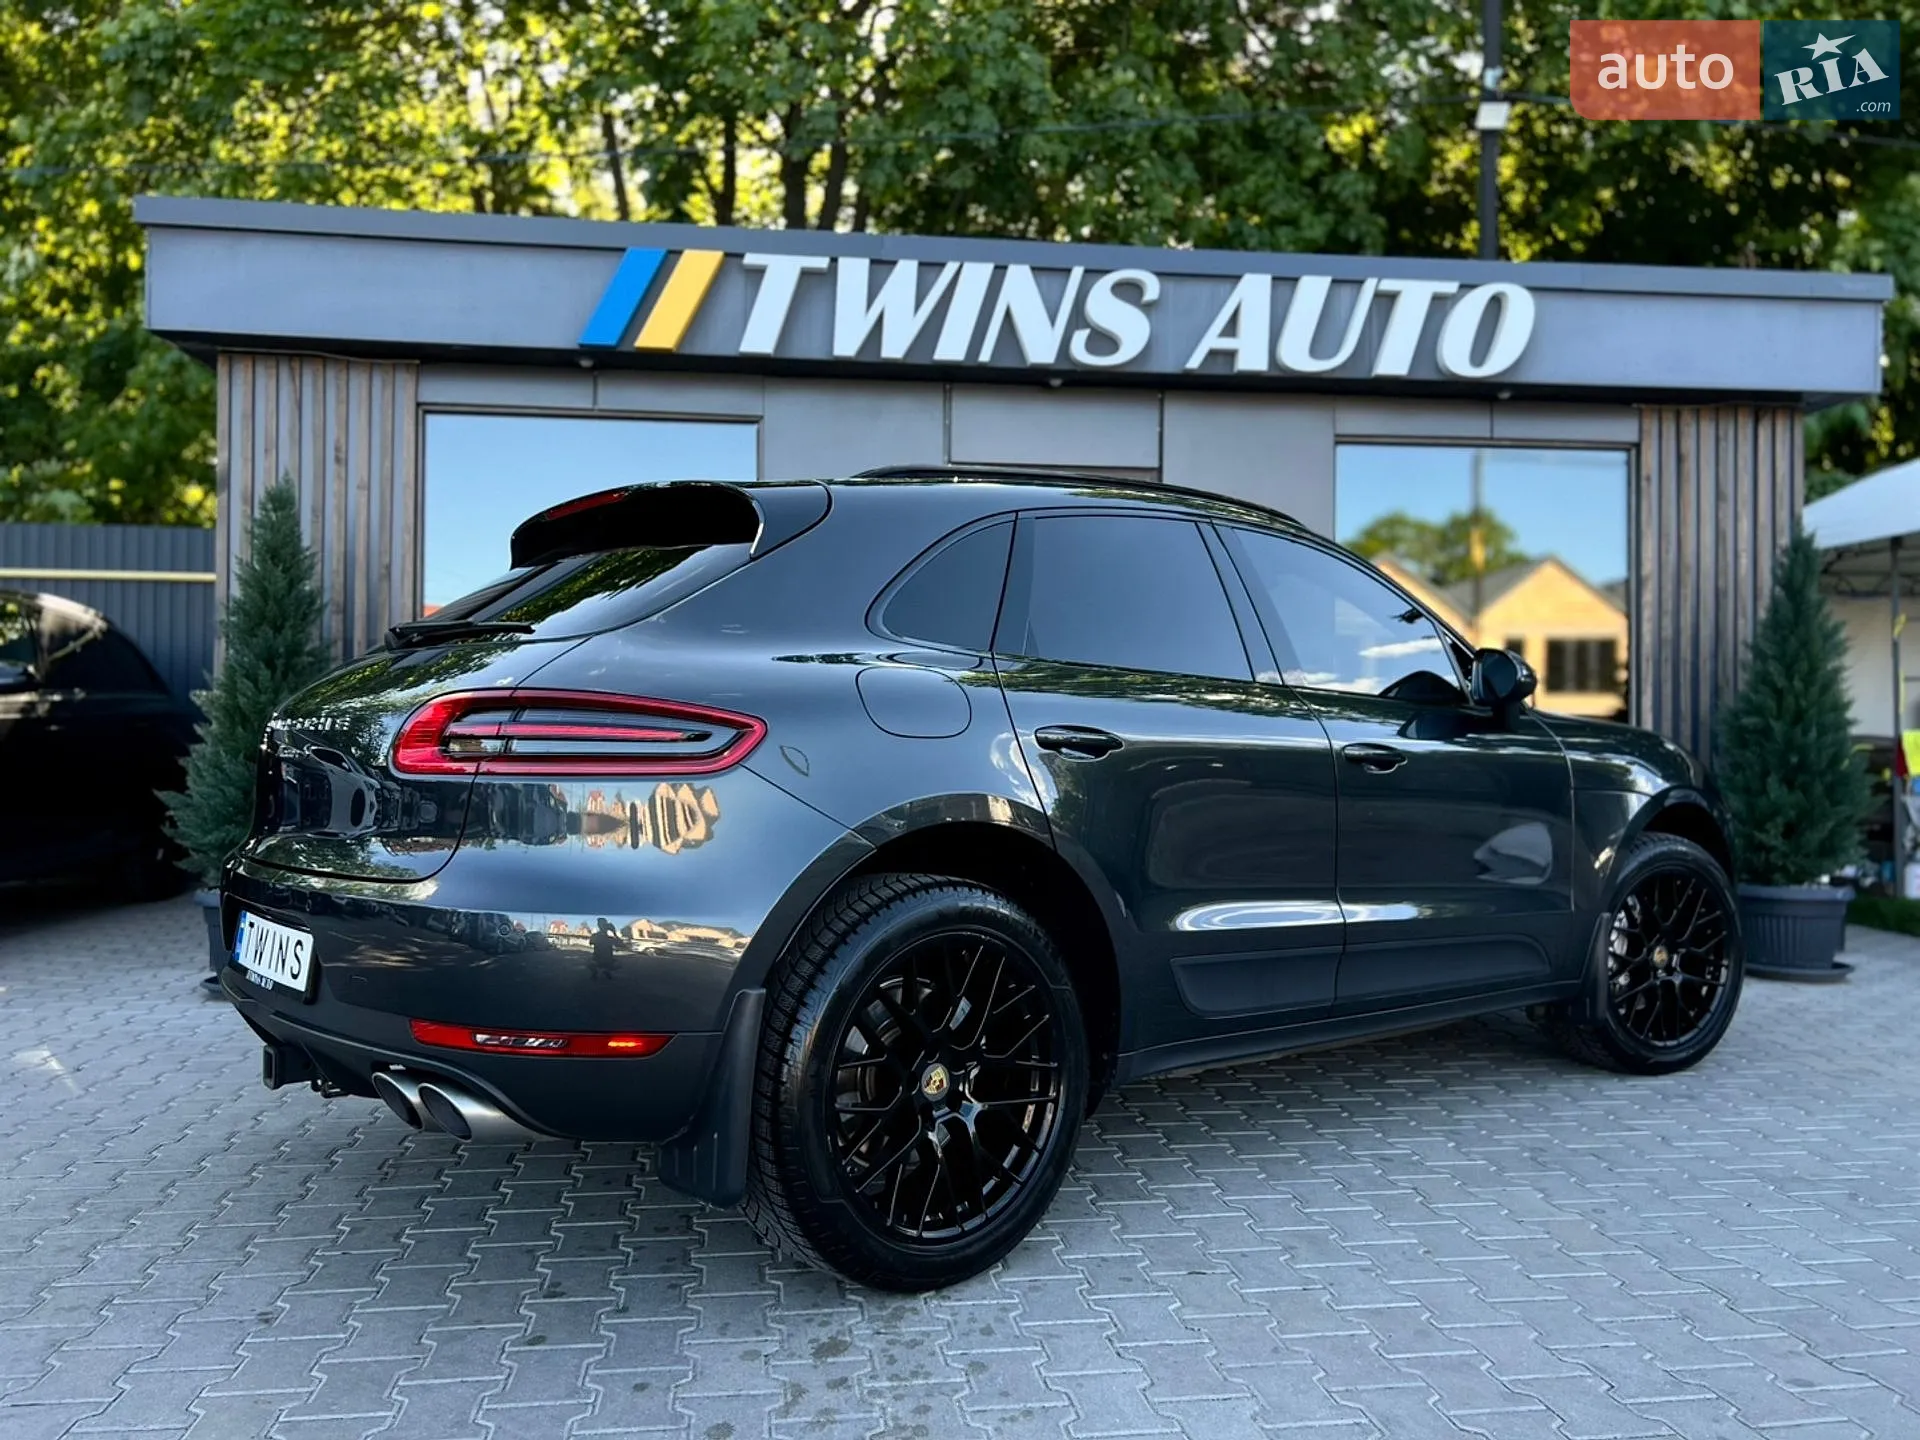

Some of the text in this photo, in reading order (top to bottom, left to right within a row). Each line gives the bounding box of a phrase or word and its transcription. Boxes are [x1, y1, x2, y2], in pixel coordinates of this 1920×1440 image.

[738, 252, 1535, 378] TWINS AUTO
[245, 921, 304, 980] TWINS
